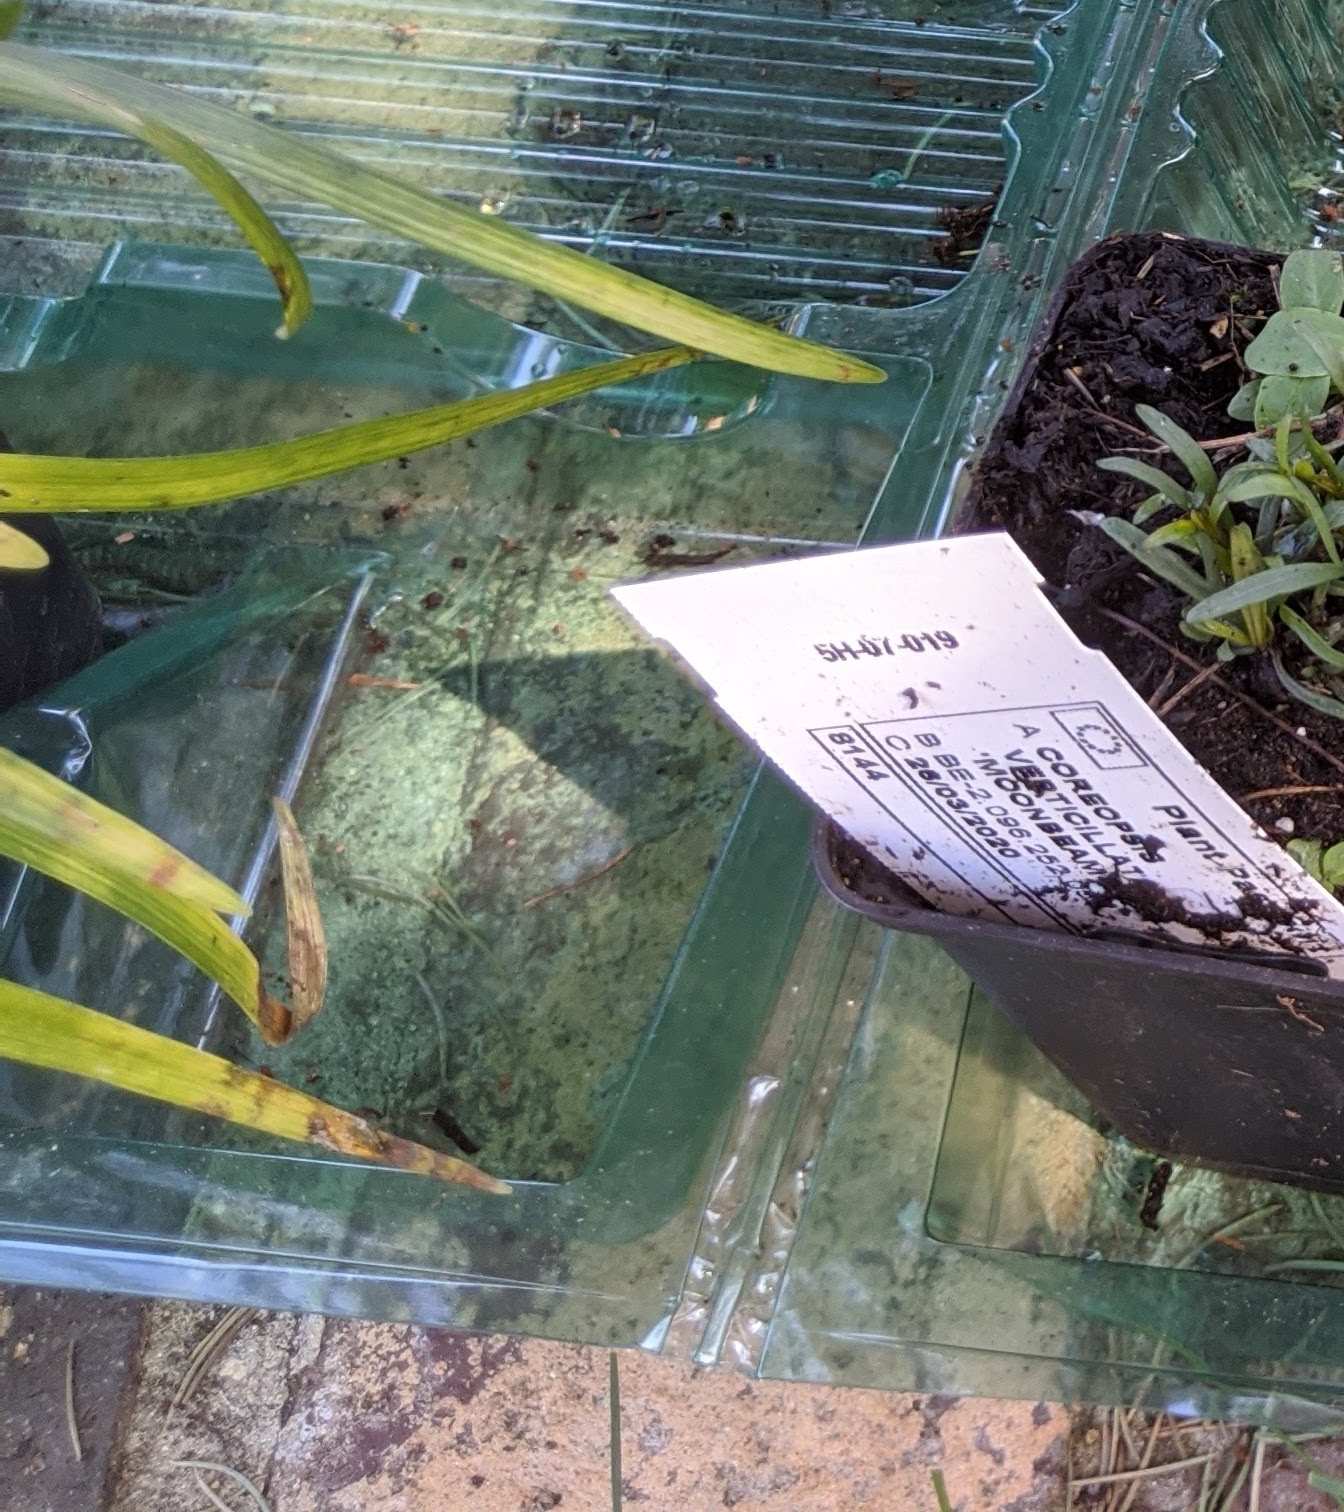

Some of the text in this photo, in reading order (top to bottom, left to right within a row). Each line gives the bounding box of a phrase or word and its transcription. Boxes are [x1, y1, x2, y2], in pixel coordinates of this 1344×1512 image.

[828, 732, 890, 781] 8144
[885, 734, 911, 751] C
[914, 733, 941, 747] B
[1005, 749, 1145, 876] VERTICILLAT
[1013, 723, 1165, 863] A COREOPSIS
[1152, 804, 1229, 862] Plant
